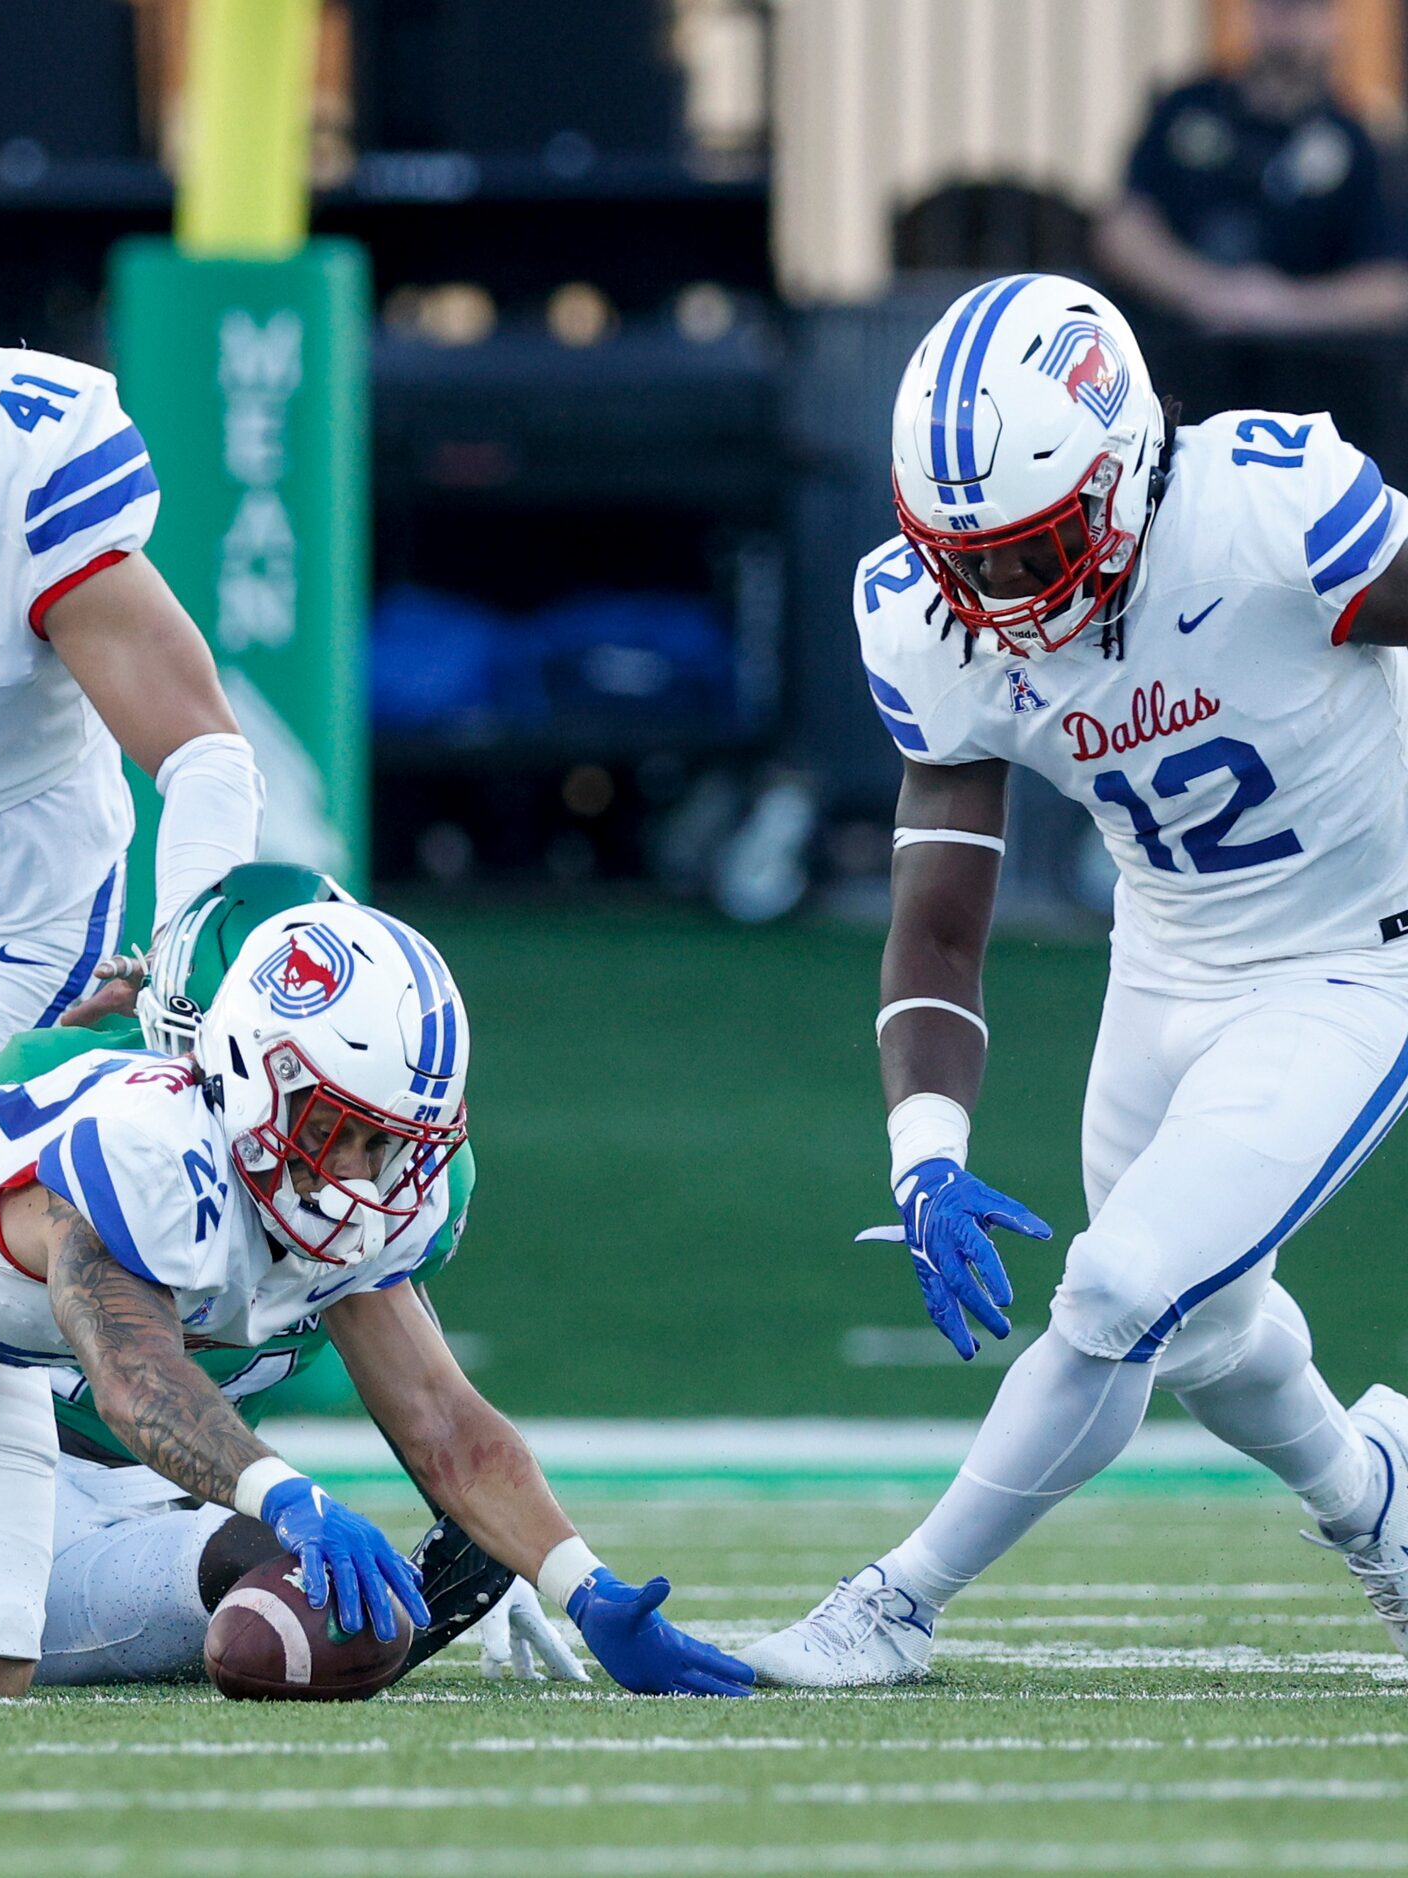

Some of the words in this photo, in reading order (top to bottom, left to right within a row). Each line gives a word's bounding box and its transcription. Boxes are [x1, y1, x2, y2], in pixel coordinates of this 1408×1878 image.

[218, 306, 301, 652] MEAN
[1231, 418, 1314, 468] 12
[948, 513, 980, 531] 214
[864, 540, 925, 614] 12
[1062, 680, 1220, 761] Dallas
[1093, 736, 1304, 874] 12
[413, 1104, 442, 1122] 214
[182, 1138, 228, 1244] 22
